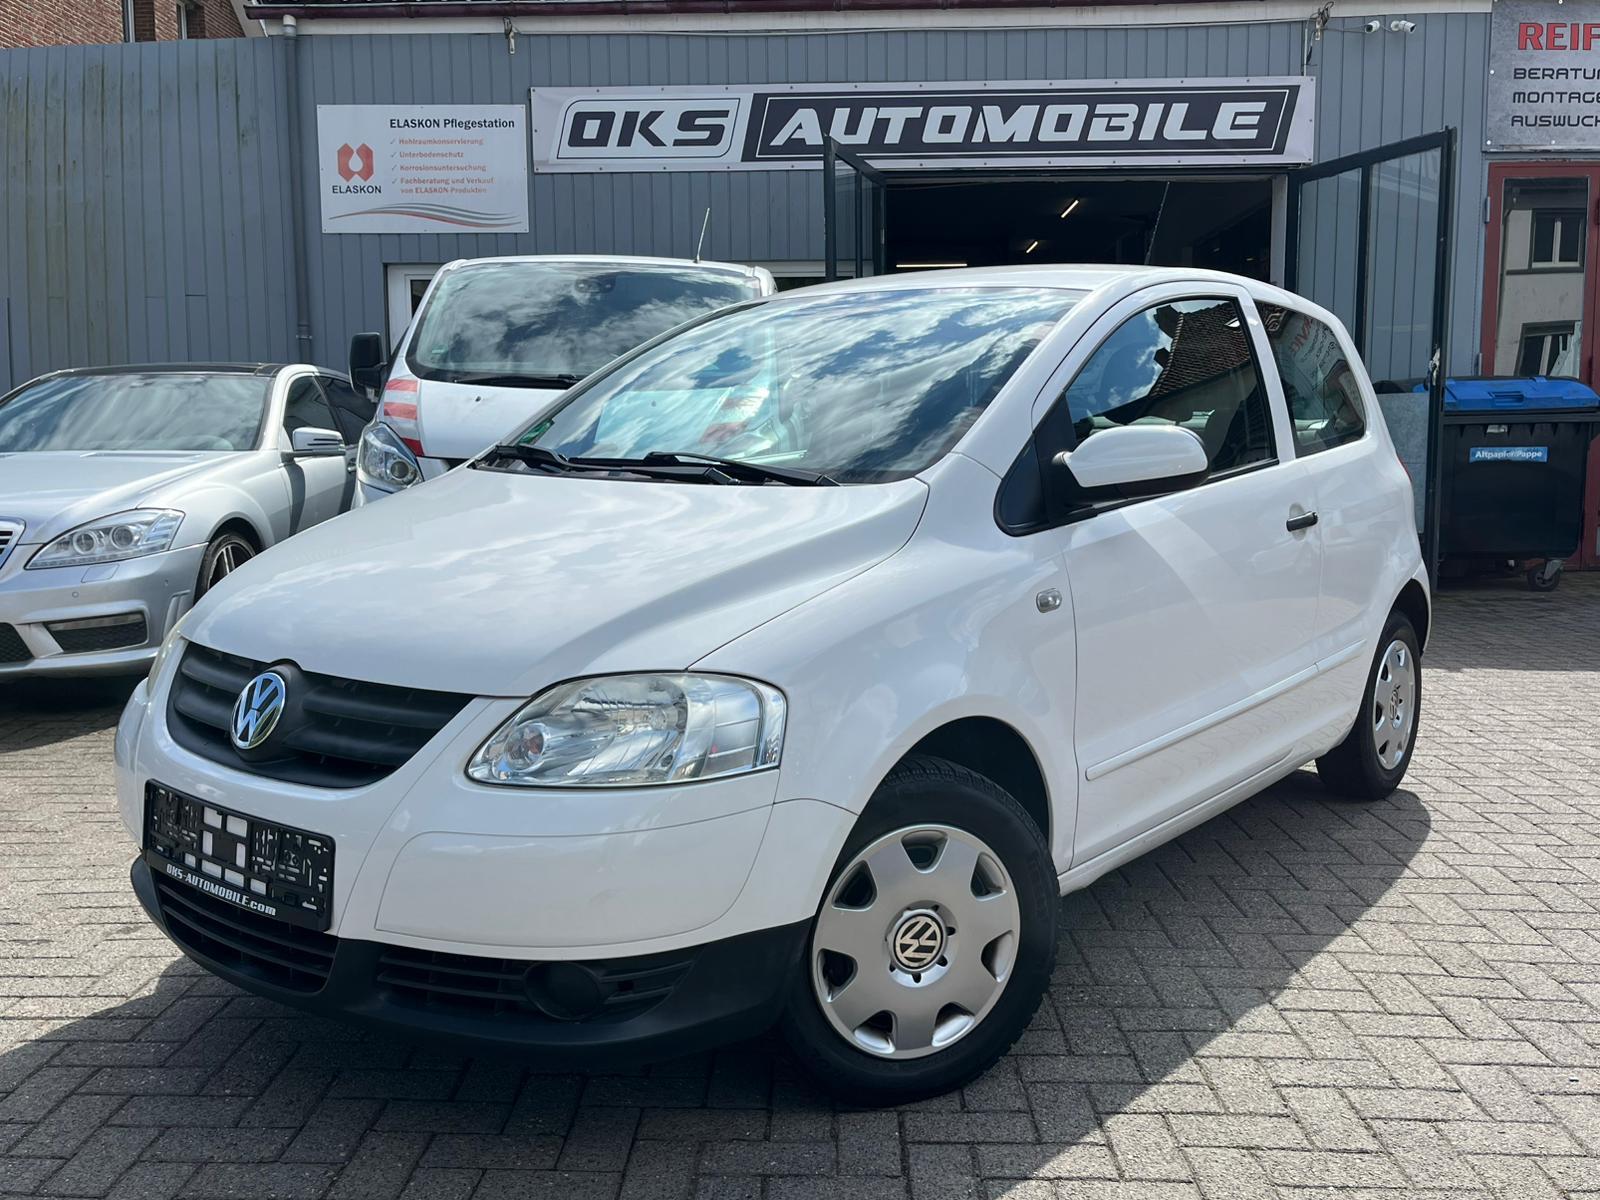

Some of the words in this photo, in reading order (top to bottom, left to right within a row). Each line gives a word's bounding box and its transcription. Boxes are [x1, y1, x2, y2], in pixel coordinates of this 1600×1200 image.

[1513, 67, 1600, 80] BERATU
[389, 118, 440, 129] ELASKON
[443, 118, 515, 130] Pflegestation
[567, 109, 730, 147] OKS
[769, 101, 1267, 146] AUTOMOBILE
[399, 151, 464, 159] Unterbodenschutz
[400, 164, 487, 172] Korrosionsuntersuchung
[400, 177, 450, 185] Fachberatung
[332, 185, 382, 194] ELASKON
